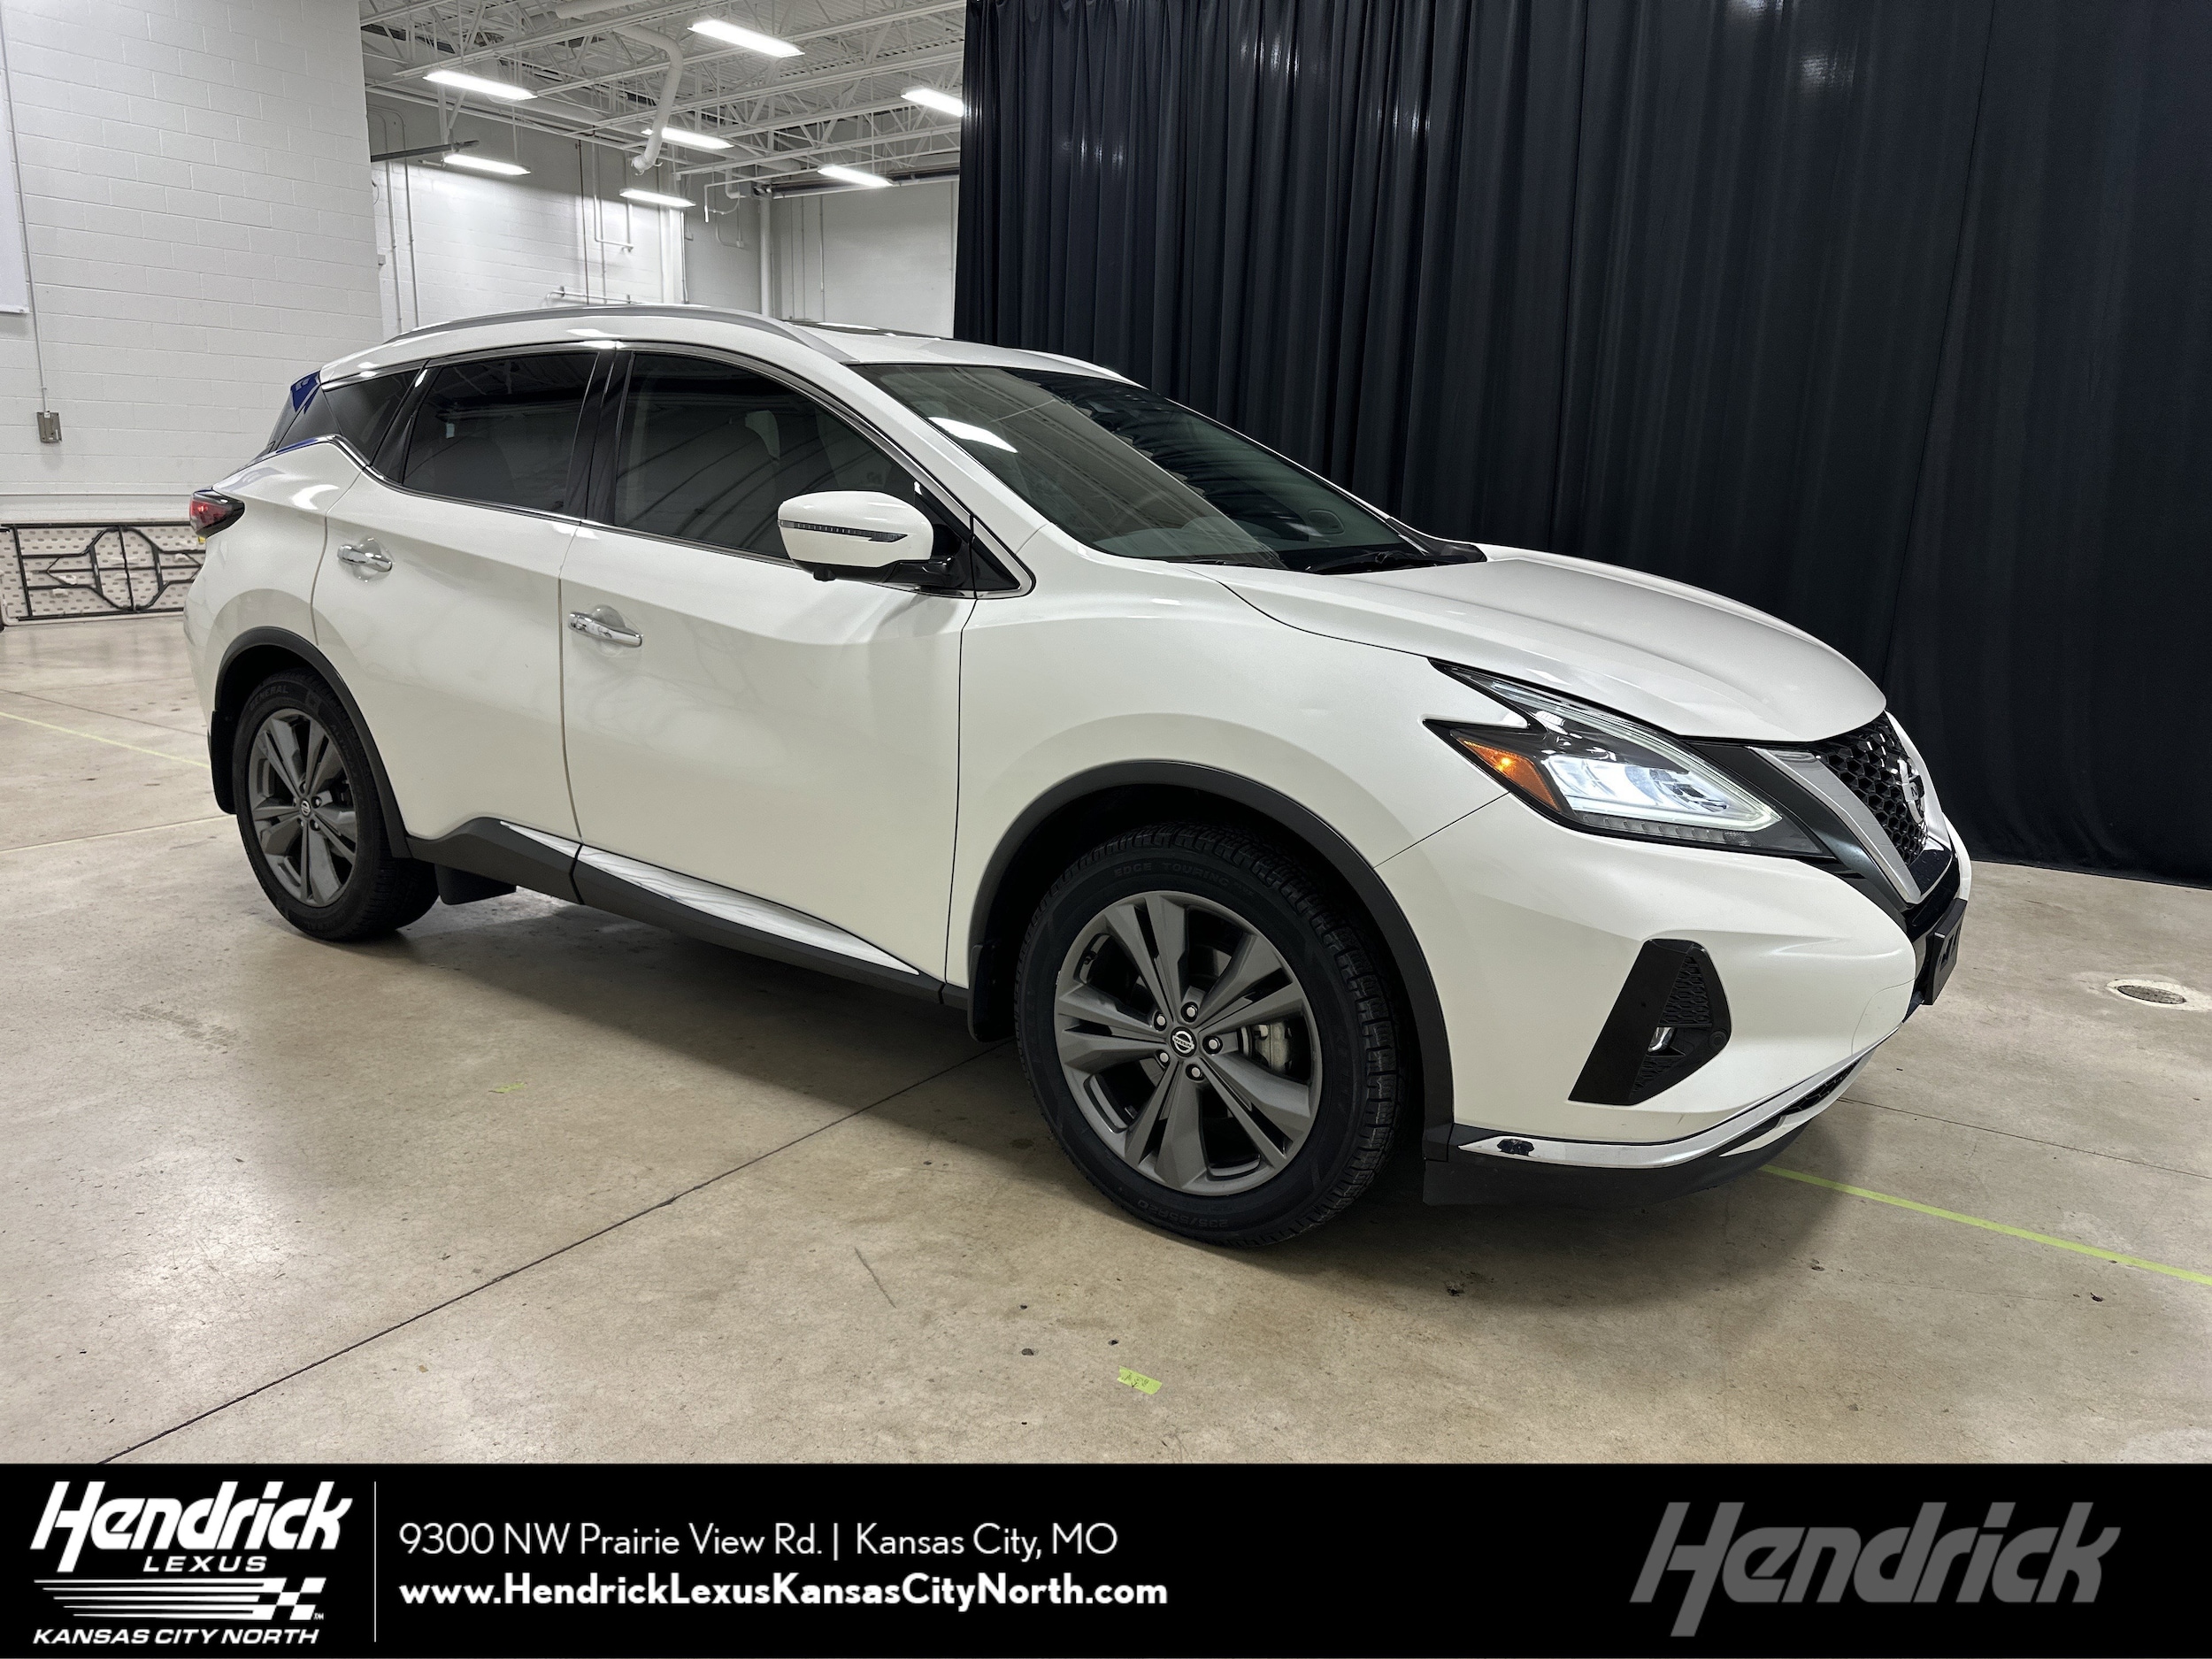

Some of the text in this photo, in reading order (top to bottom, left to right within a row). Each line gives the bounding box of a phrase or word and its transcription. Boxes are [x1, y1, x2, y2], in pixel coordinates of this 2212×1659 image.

[249, 684, 289, 711] GENERAL
[1113, 861, 1153, 878] EDGE
[1162, 861, 1230, 887] TOURING
[1137, 1199, 1228, 1228] 235/55R20
